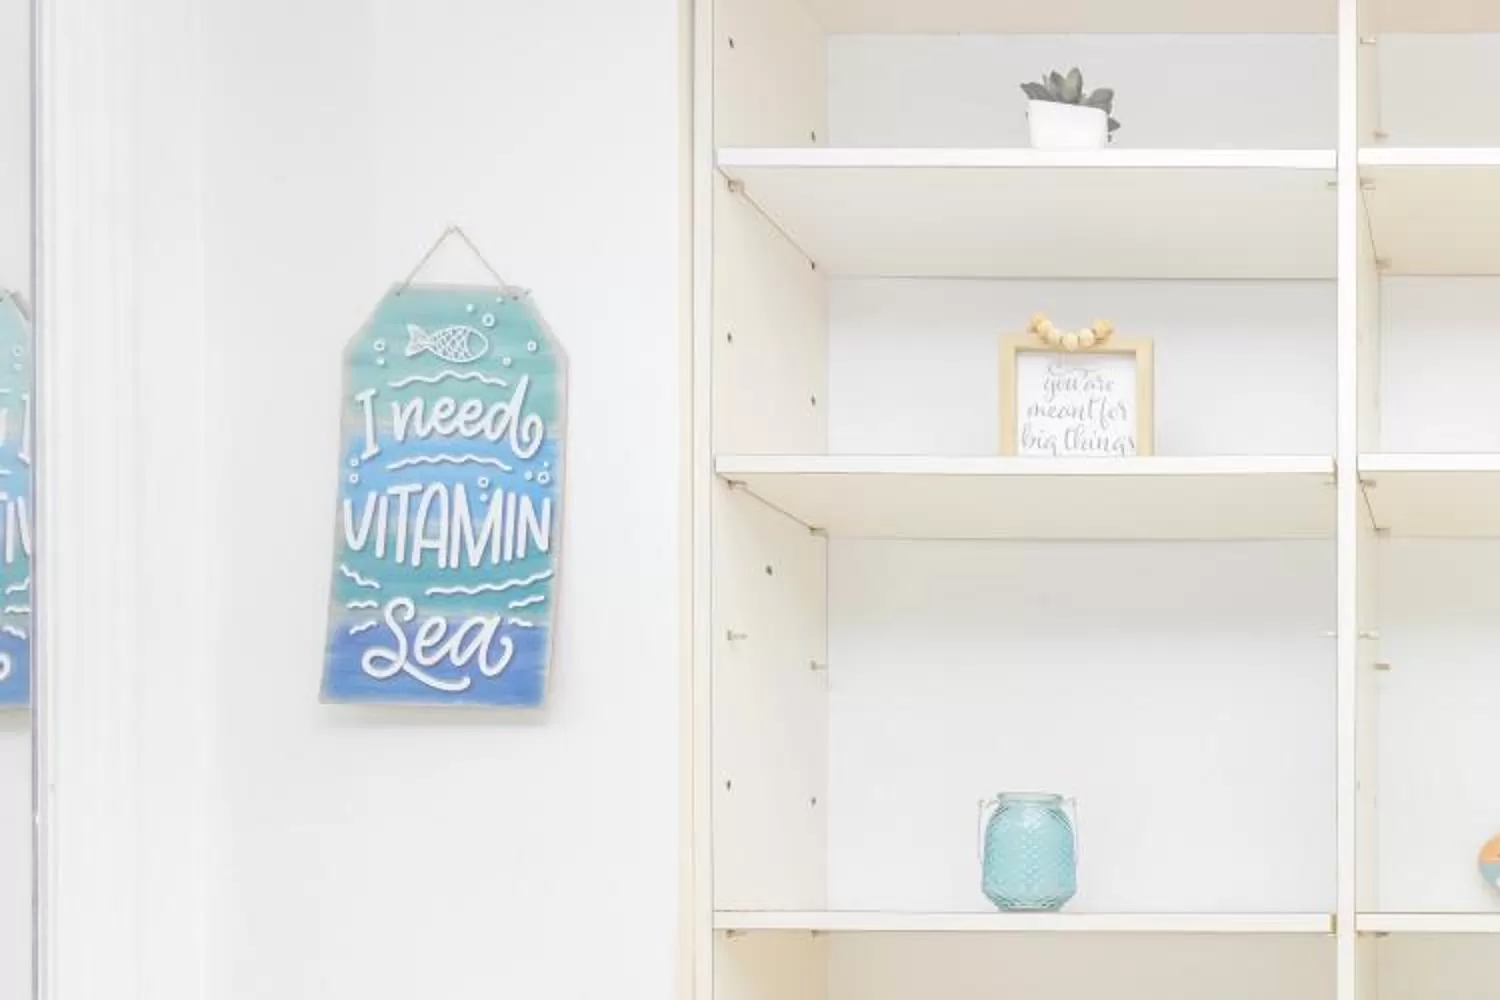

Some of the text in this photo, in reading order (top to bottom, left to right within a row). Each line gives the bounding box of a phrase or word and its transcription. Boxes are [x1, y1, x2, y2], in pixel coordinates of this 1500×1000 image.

[354, 374, 545, 461] I need
[342, 481, 552, 570] VITAMIN
[361, 596, 513, 692] Sea
